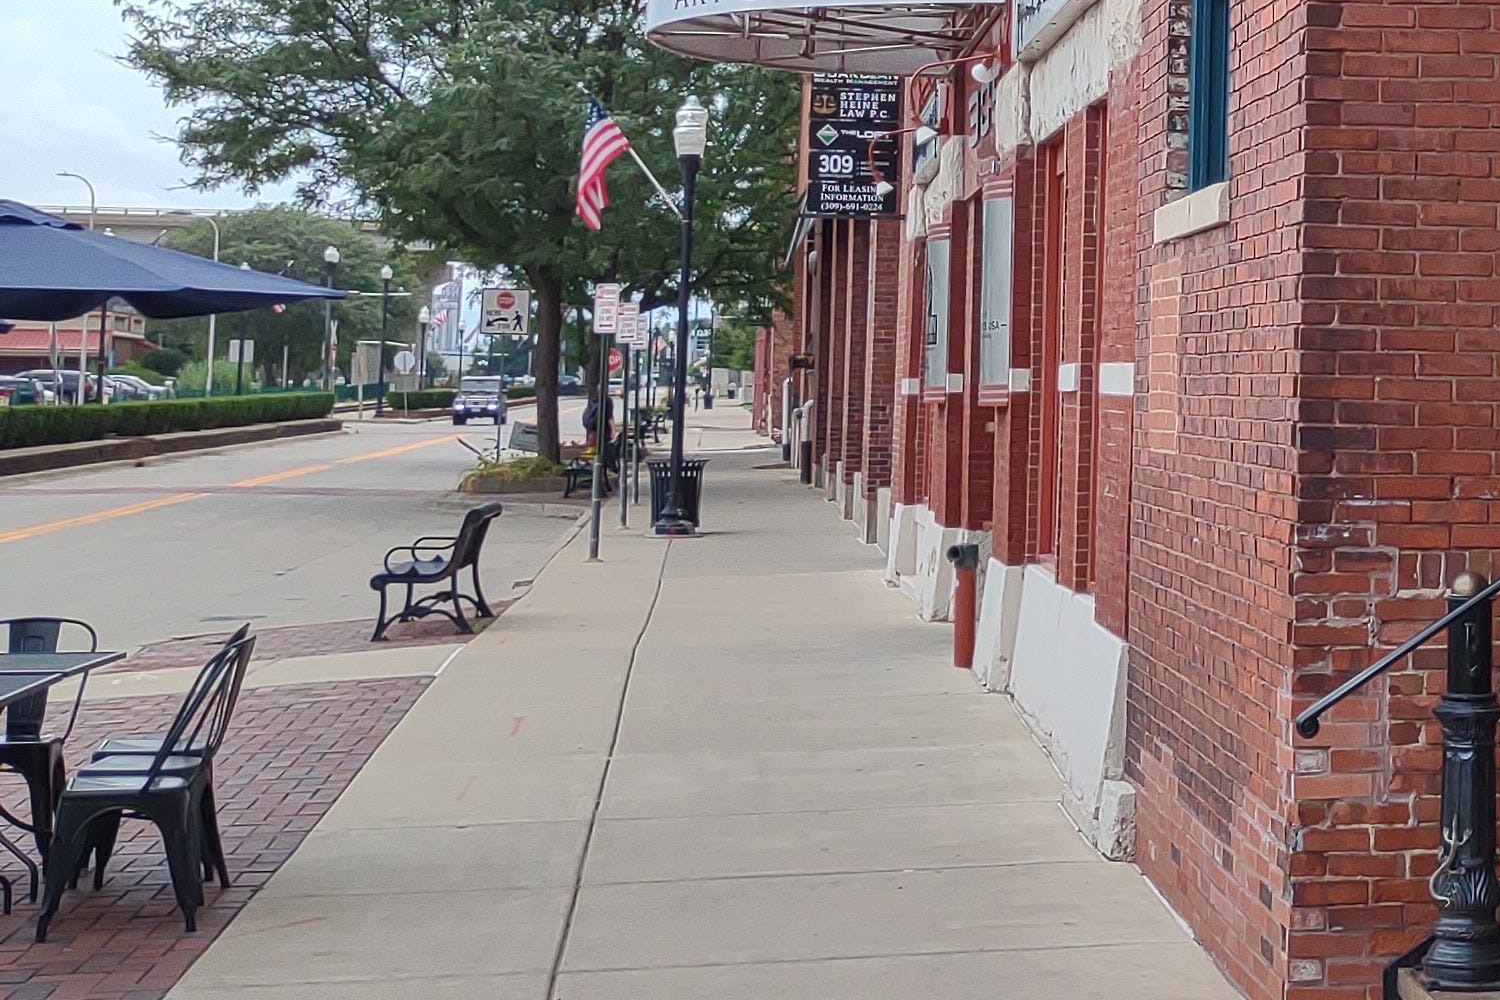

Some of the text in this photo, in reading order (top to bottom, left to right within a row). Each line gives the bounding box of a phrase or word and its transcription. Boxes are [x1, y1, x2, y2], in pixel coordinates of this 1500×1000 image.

[840, 92, 896, 102] STEPHEN
[840, 101, 879, 110] HEINE
[840, 109, 865, 118] LAW
[818, 155, 853, 173] 309
[822, 184, 879, 193] FOR LEASIN
[821, 193, 883, 202] INFORMATION
